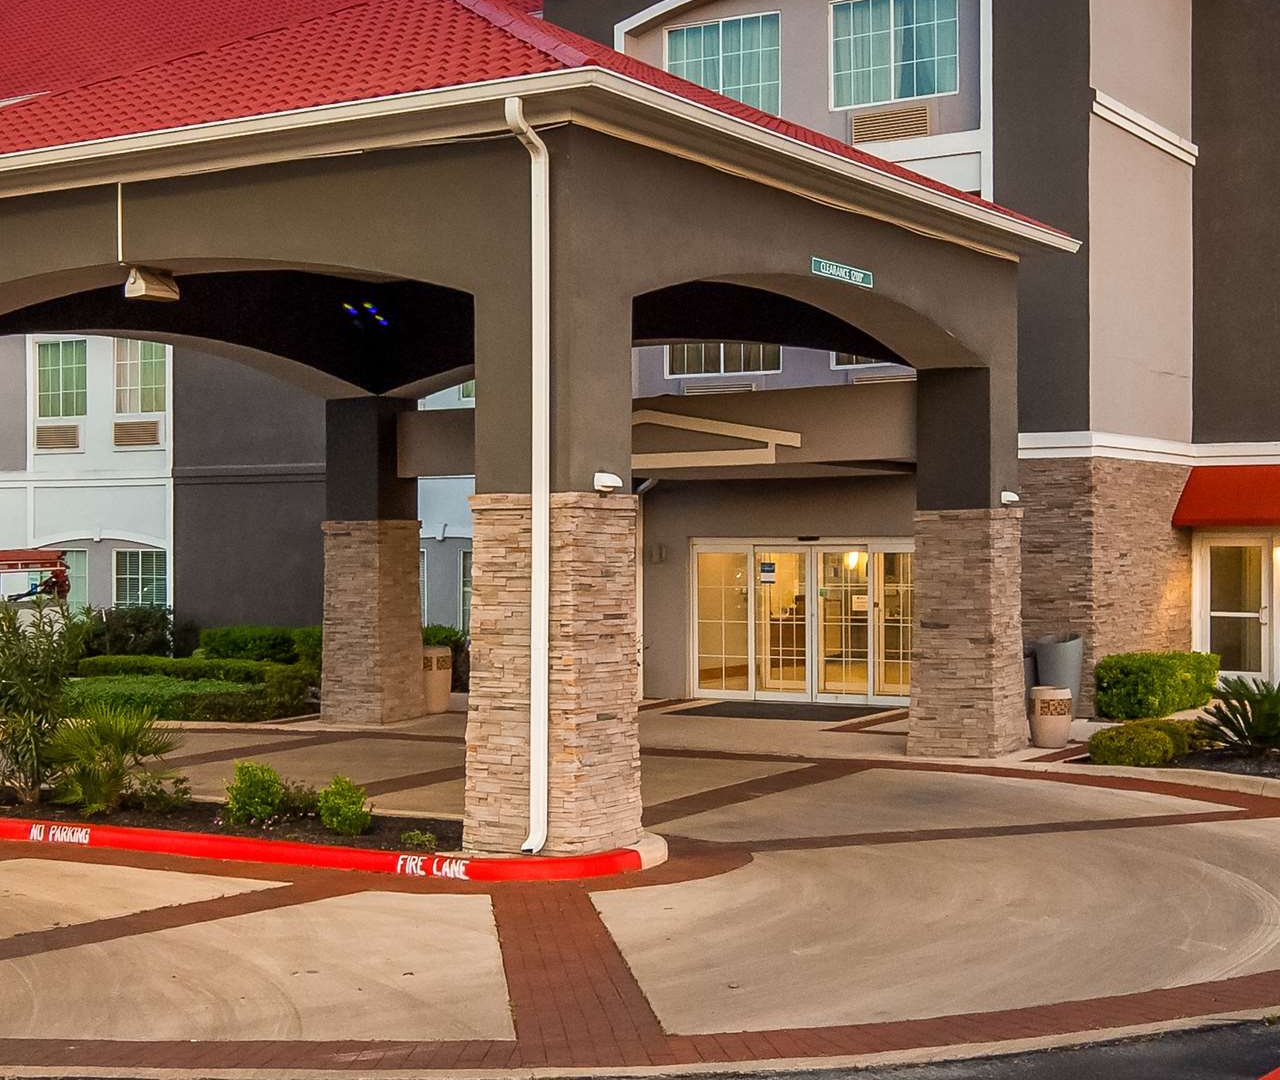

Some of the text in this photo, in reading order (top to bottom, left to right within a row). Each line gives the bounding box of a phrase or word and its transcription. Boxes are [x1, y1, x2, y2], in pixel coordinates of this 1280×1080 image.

[29, 823, 91, 844] NO PARKING
[397, 855, 470, 880] FIRE LANE
